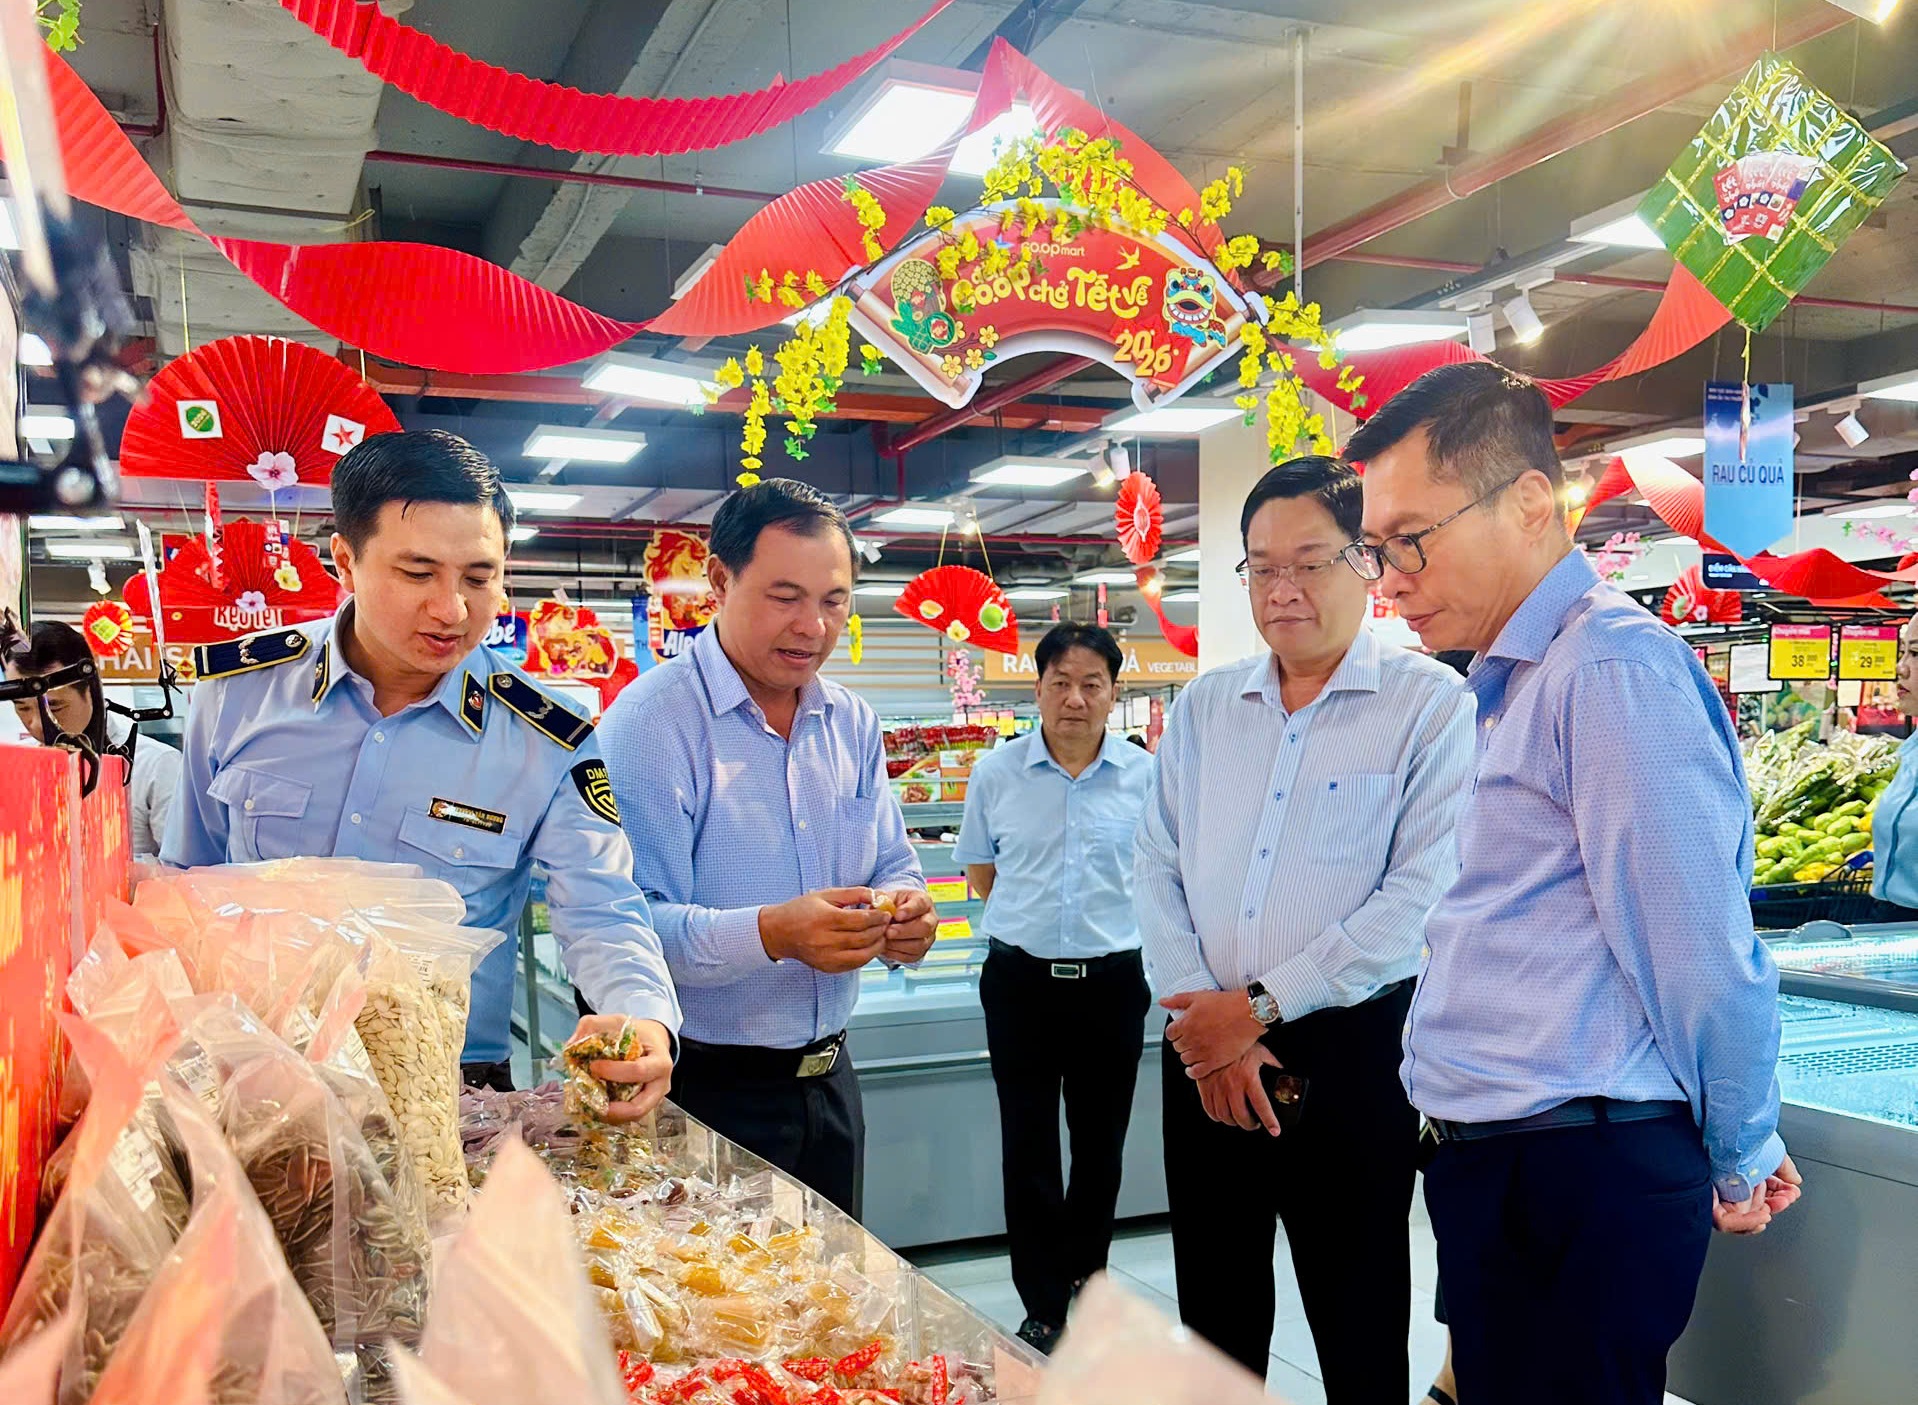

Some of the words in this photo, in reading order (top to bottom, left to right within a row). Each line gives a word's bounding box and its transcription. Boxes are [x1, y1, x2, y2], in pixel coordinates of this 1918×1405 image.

[1067, 267, 1140, 319] Tết
[1113, 330, 1172, 377] 2026
[1712, 464, 1735, 483] RAU
[1738, 458, 1756, 483] CỦ
[1758, 458, 1784, 483] QUẢ
[1003, 655, 1038, 673] RA
[1860, 656, 1873, 669] 29
